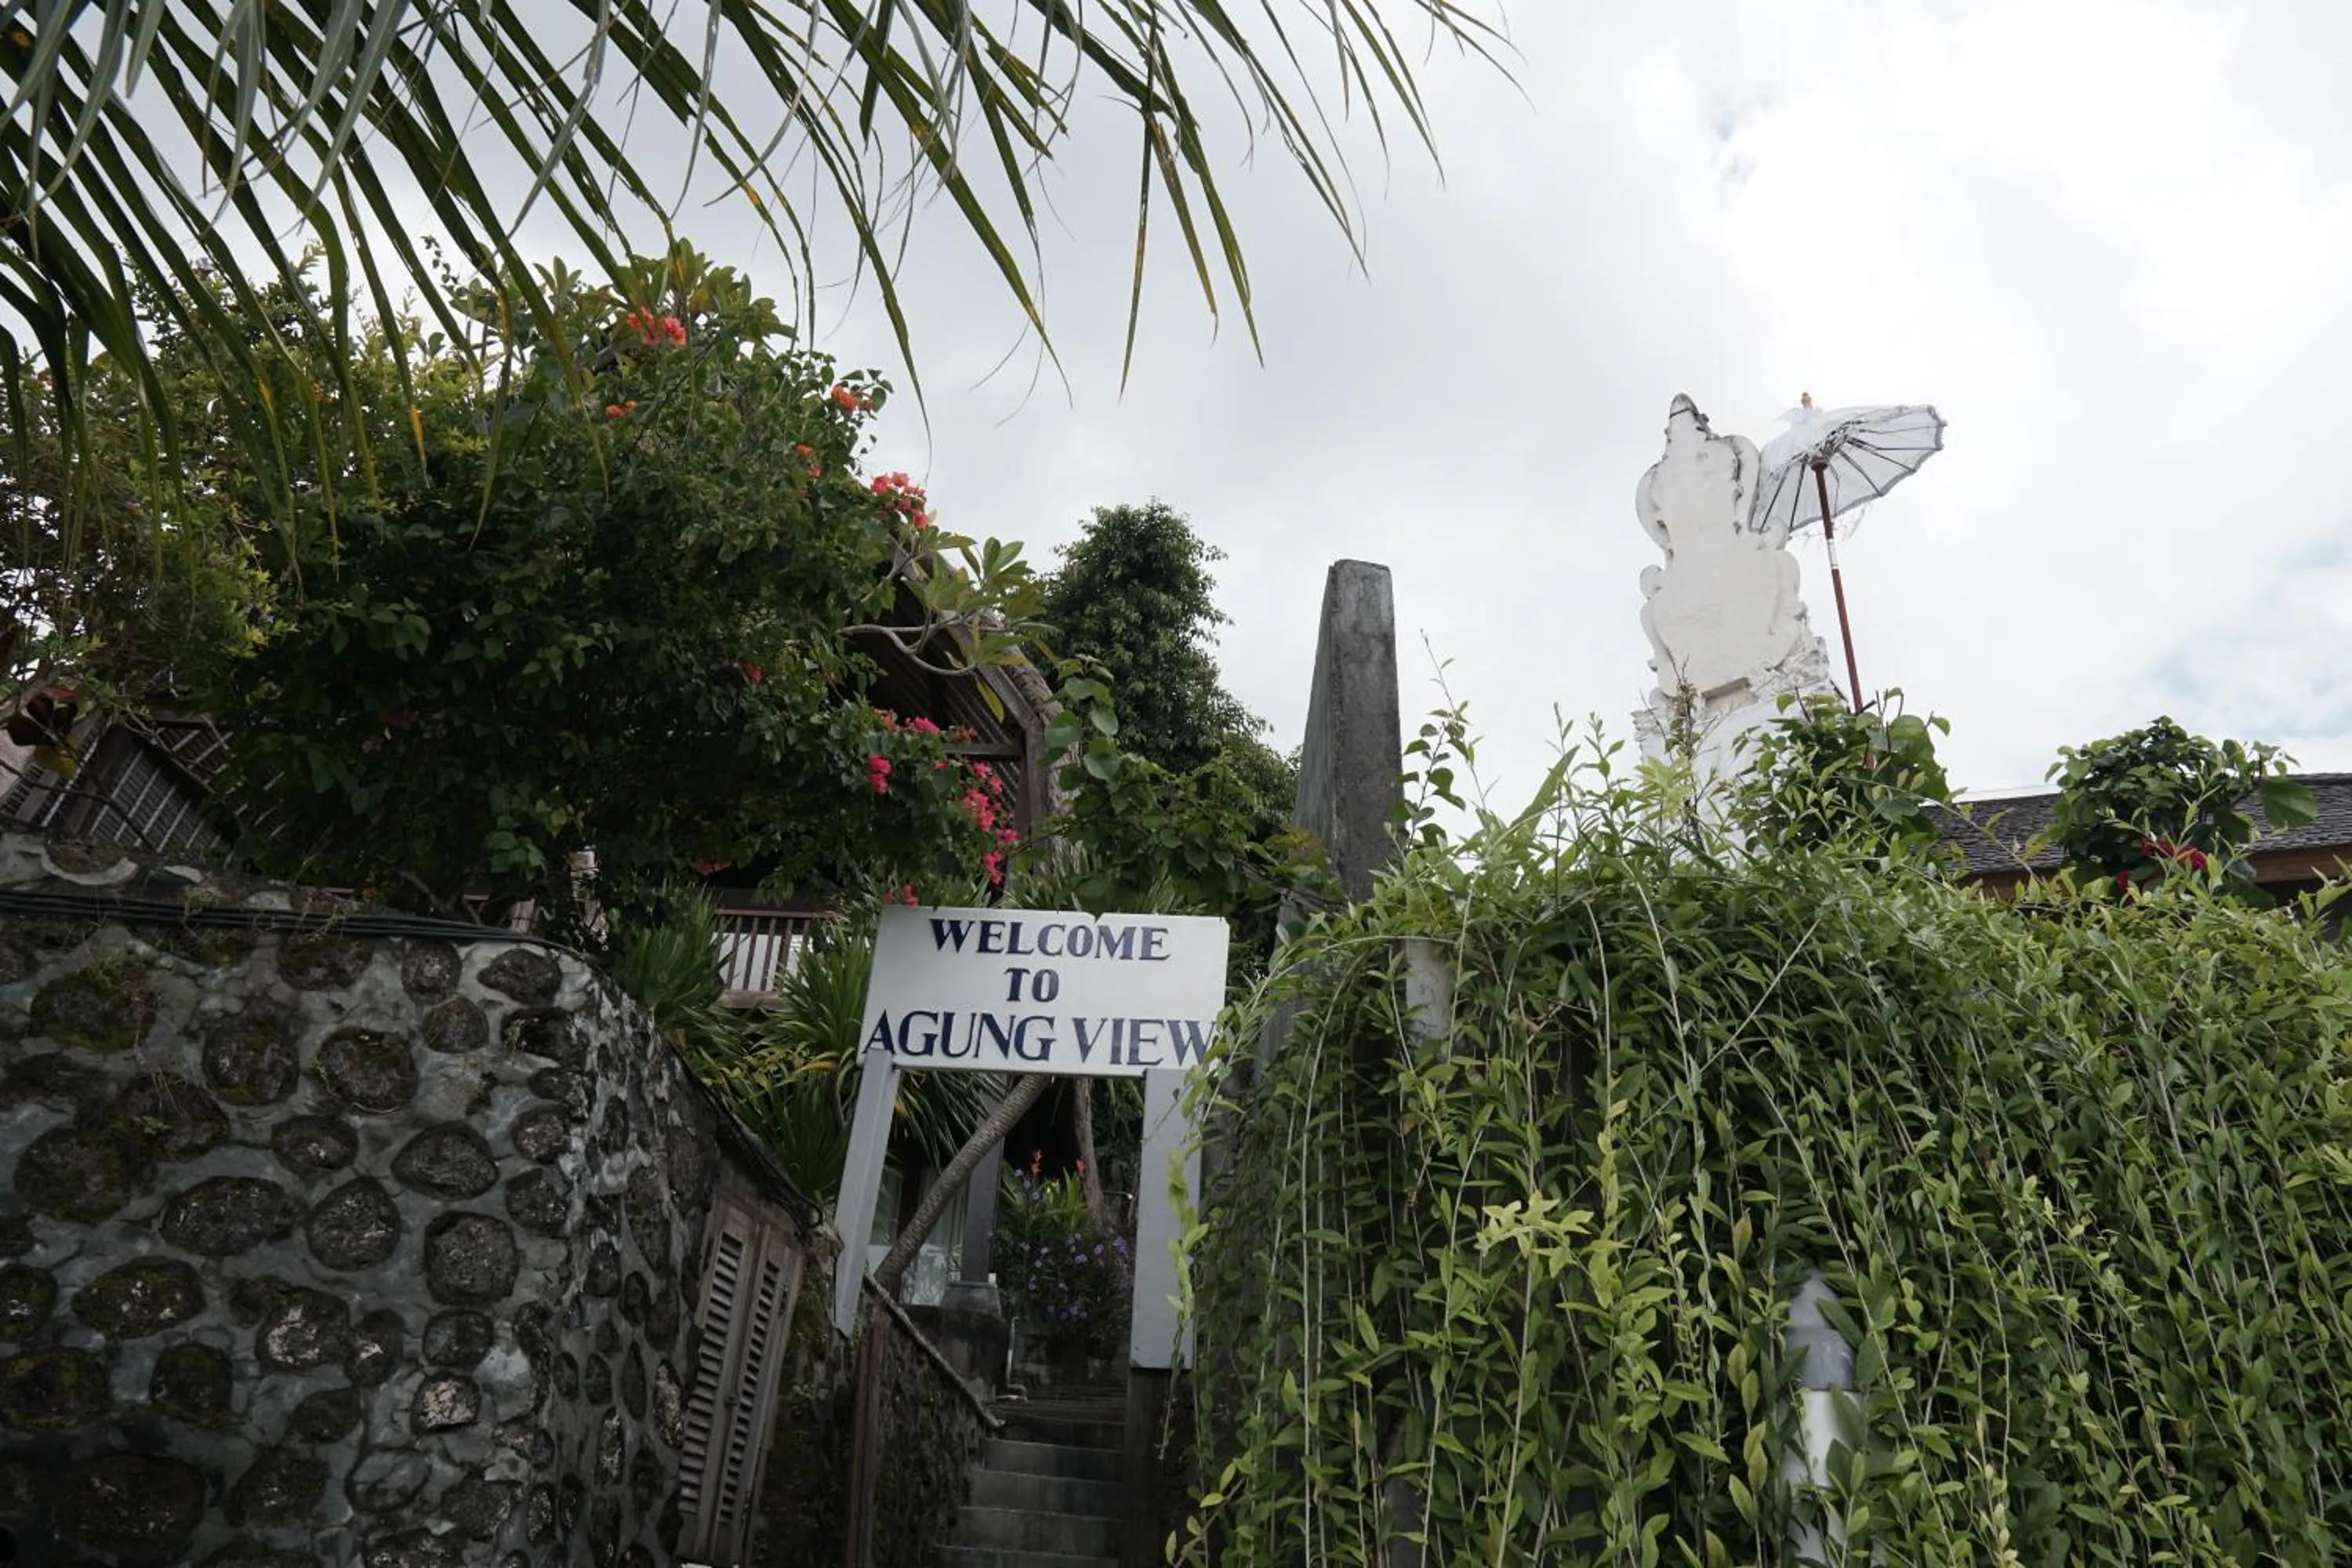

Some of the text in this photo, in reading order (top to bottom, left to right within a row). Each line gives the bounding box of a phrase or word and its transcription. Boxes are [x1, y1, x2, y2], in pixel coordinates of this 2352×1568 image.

[930, 918, 1171, 961] WELCOME
[1004, 967, 1059, 1003] TO
[862, 1009, 1217, 1066] AGUNG VIEW
